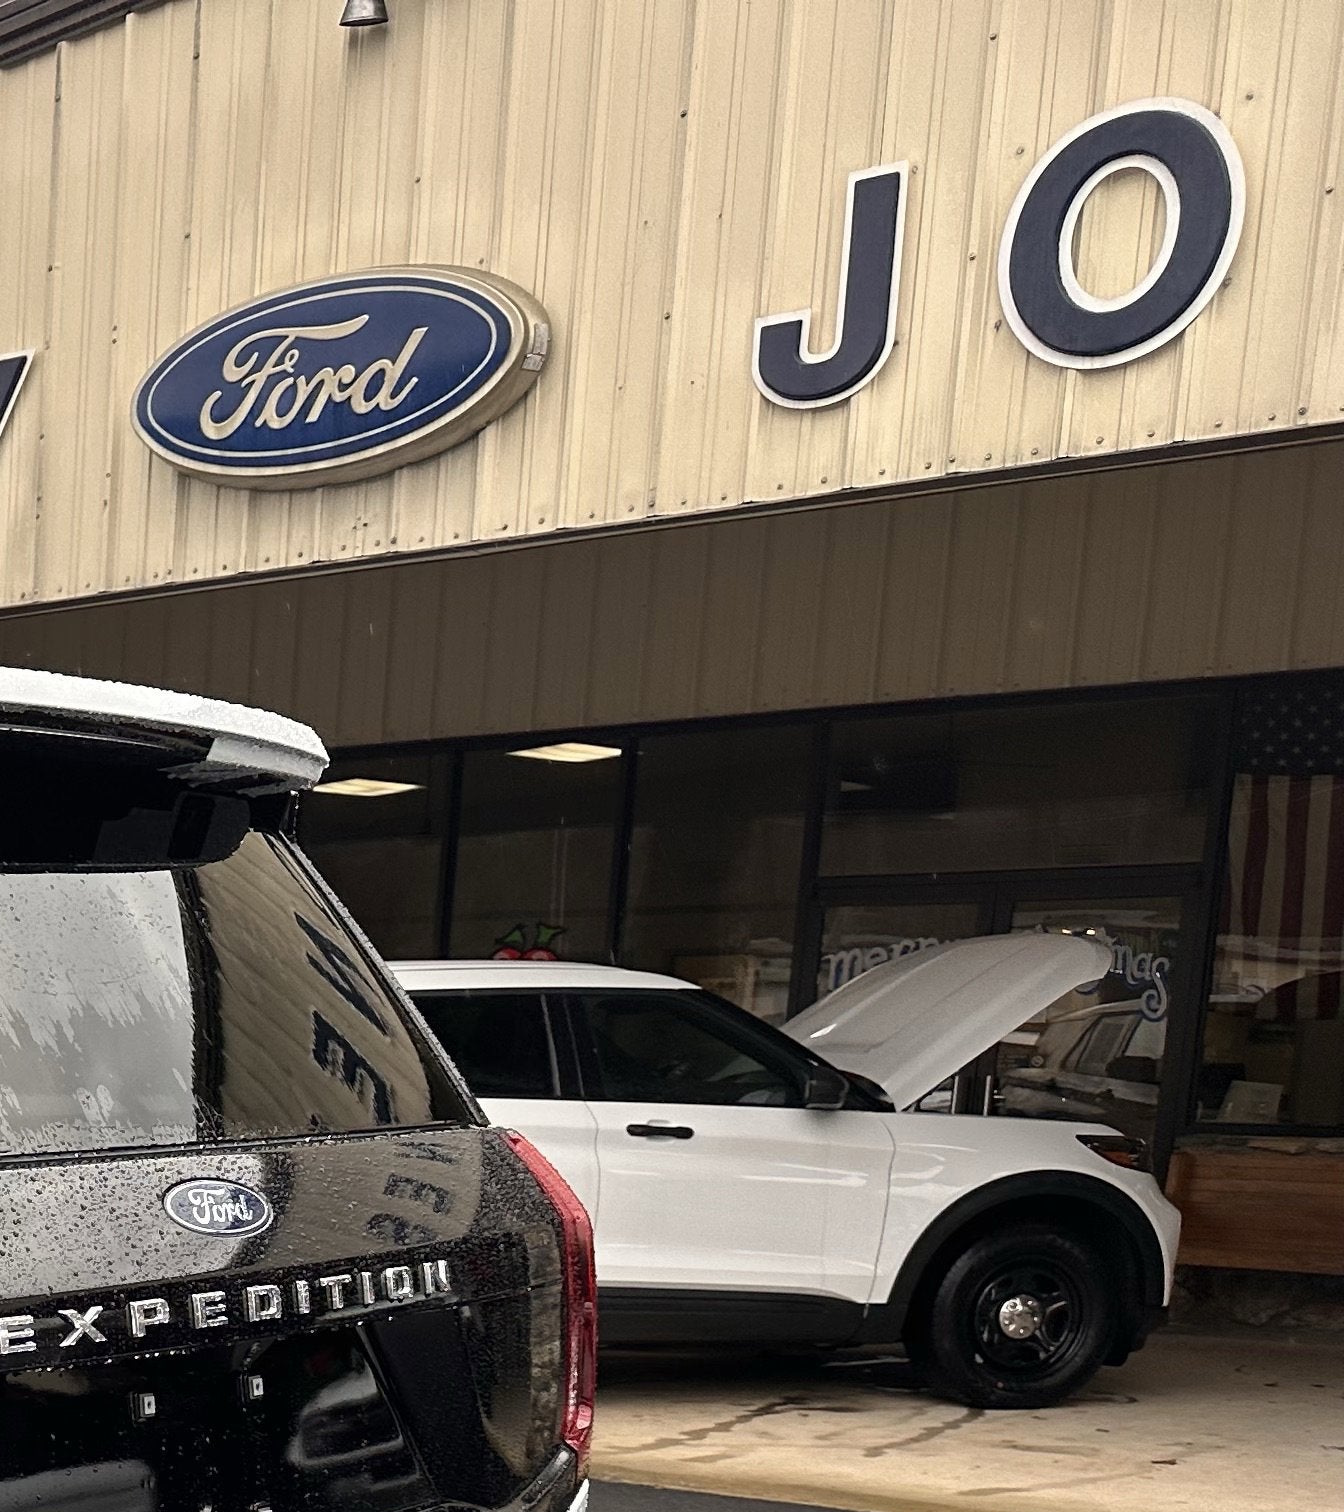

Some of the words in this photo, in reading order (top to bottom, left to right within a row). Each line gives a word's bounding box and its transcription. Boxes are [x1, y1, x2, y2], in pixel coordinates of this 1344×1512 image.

[751, 95, 1247, 410] JO
[198, 313, 429, 441] Ford
[187, 1188, 253, 1225] Ford
